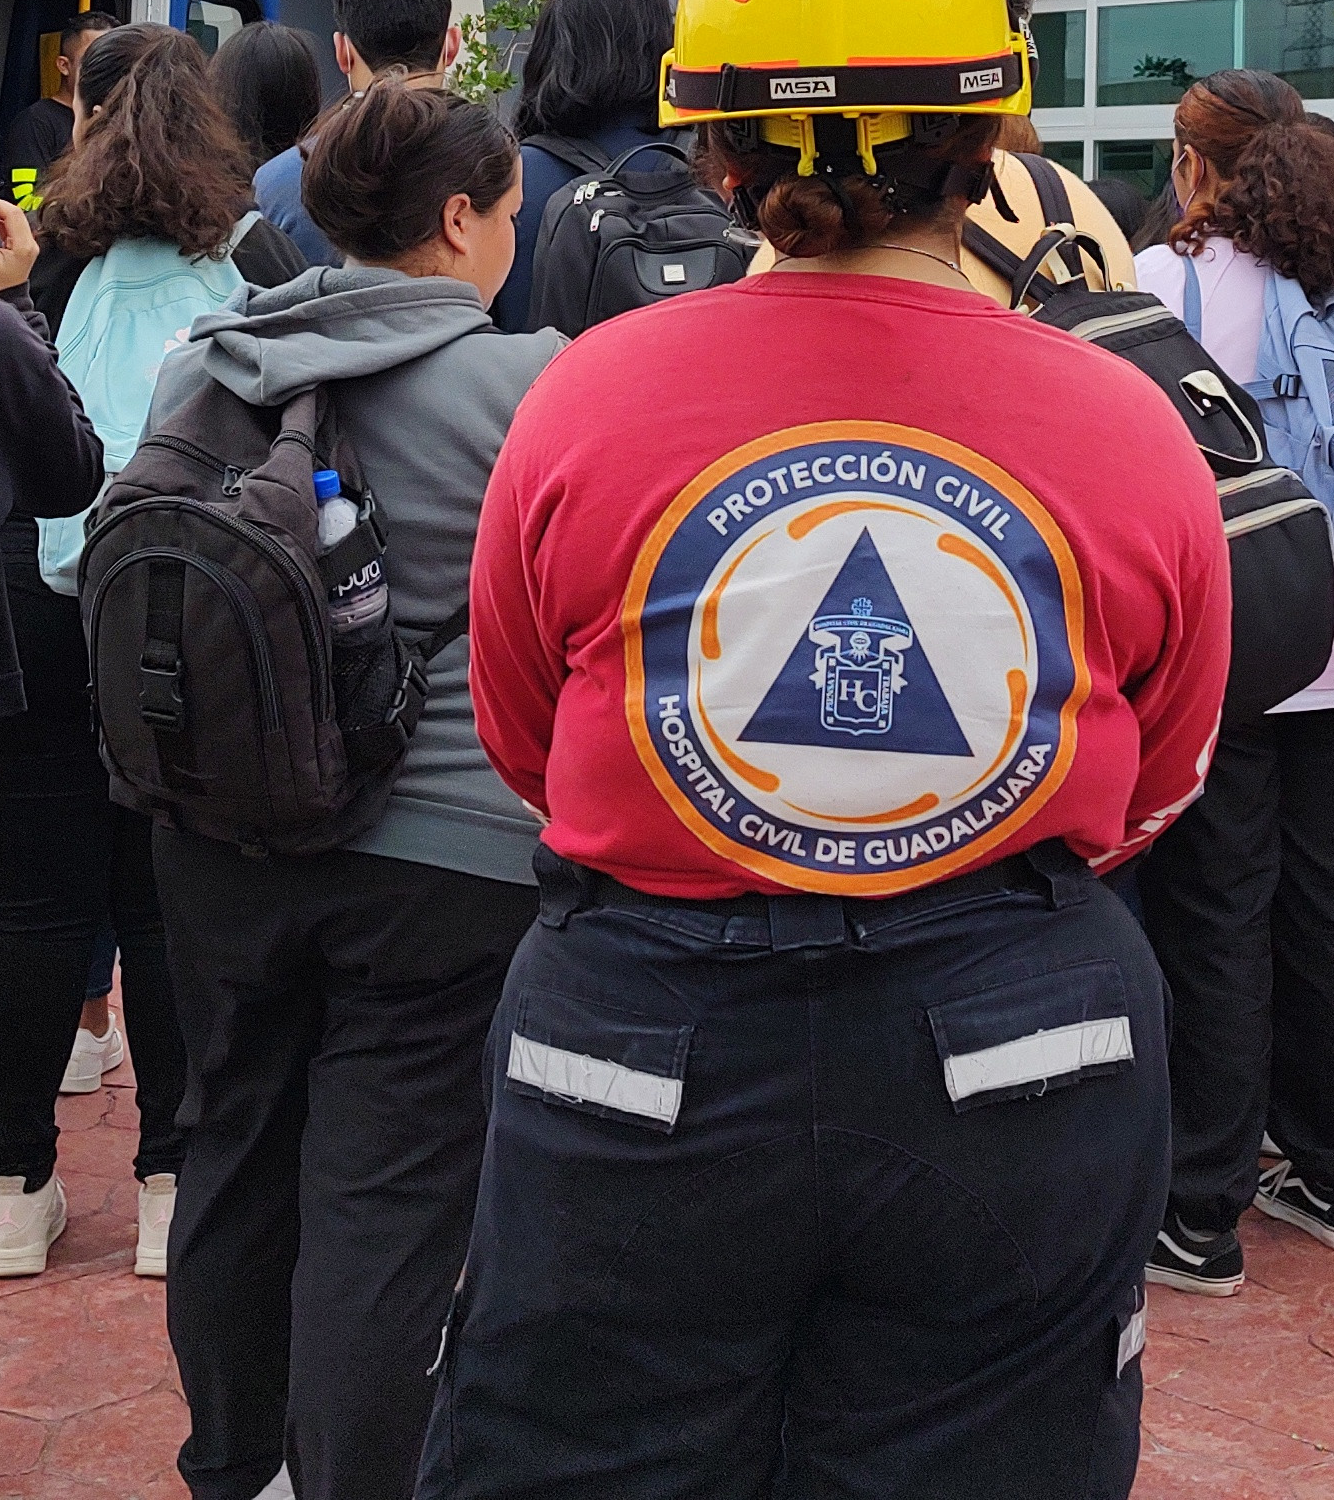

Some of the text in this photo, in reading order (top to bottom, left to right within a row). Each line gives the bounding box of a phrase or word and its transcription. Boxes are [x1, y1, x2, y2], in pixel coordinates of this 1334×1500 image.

[774, 81, 831, 95] MSA
[963, 72, 1000, 89] MSA
[707, 451, 1012, 541] PROTECCIÓN CIVIL
[658, 694, 1052, 866] HOSPITAL CIVIL DE GUADALAJARA
